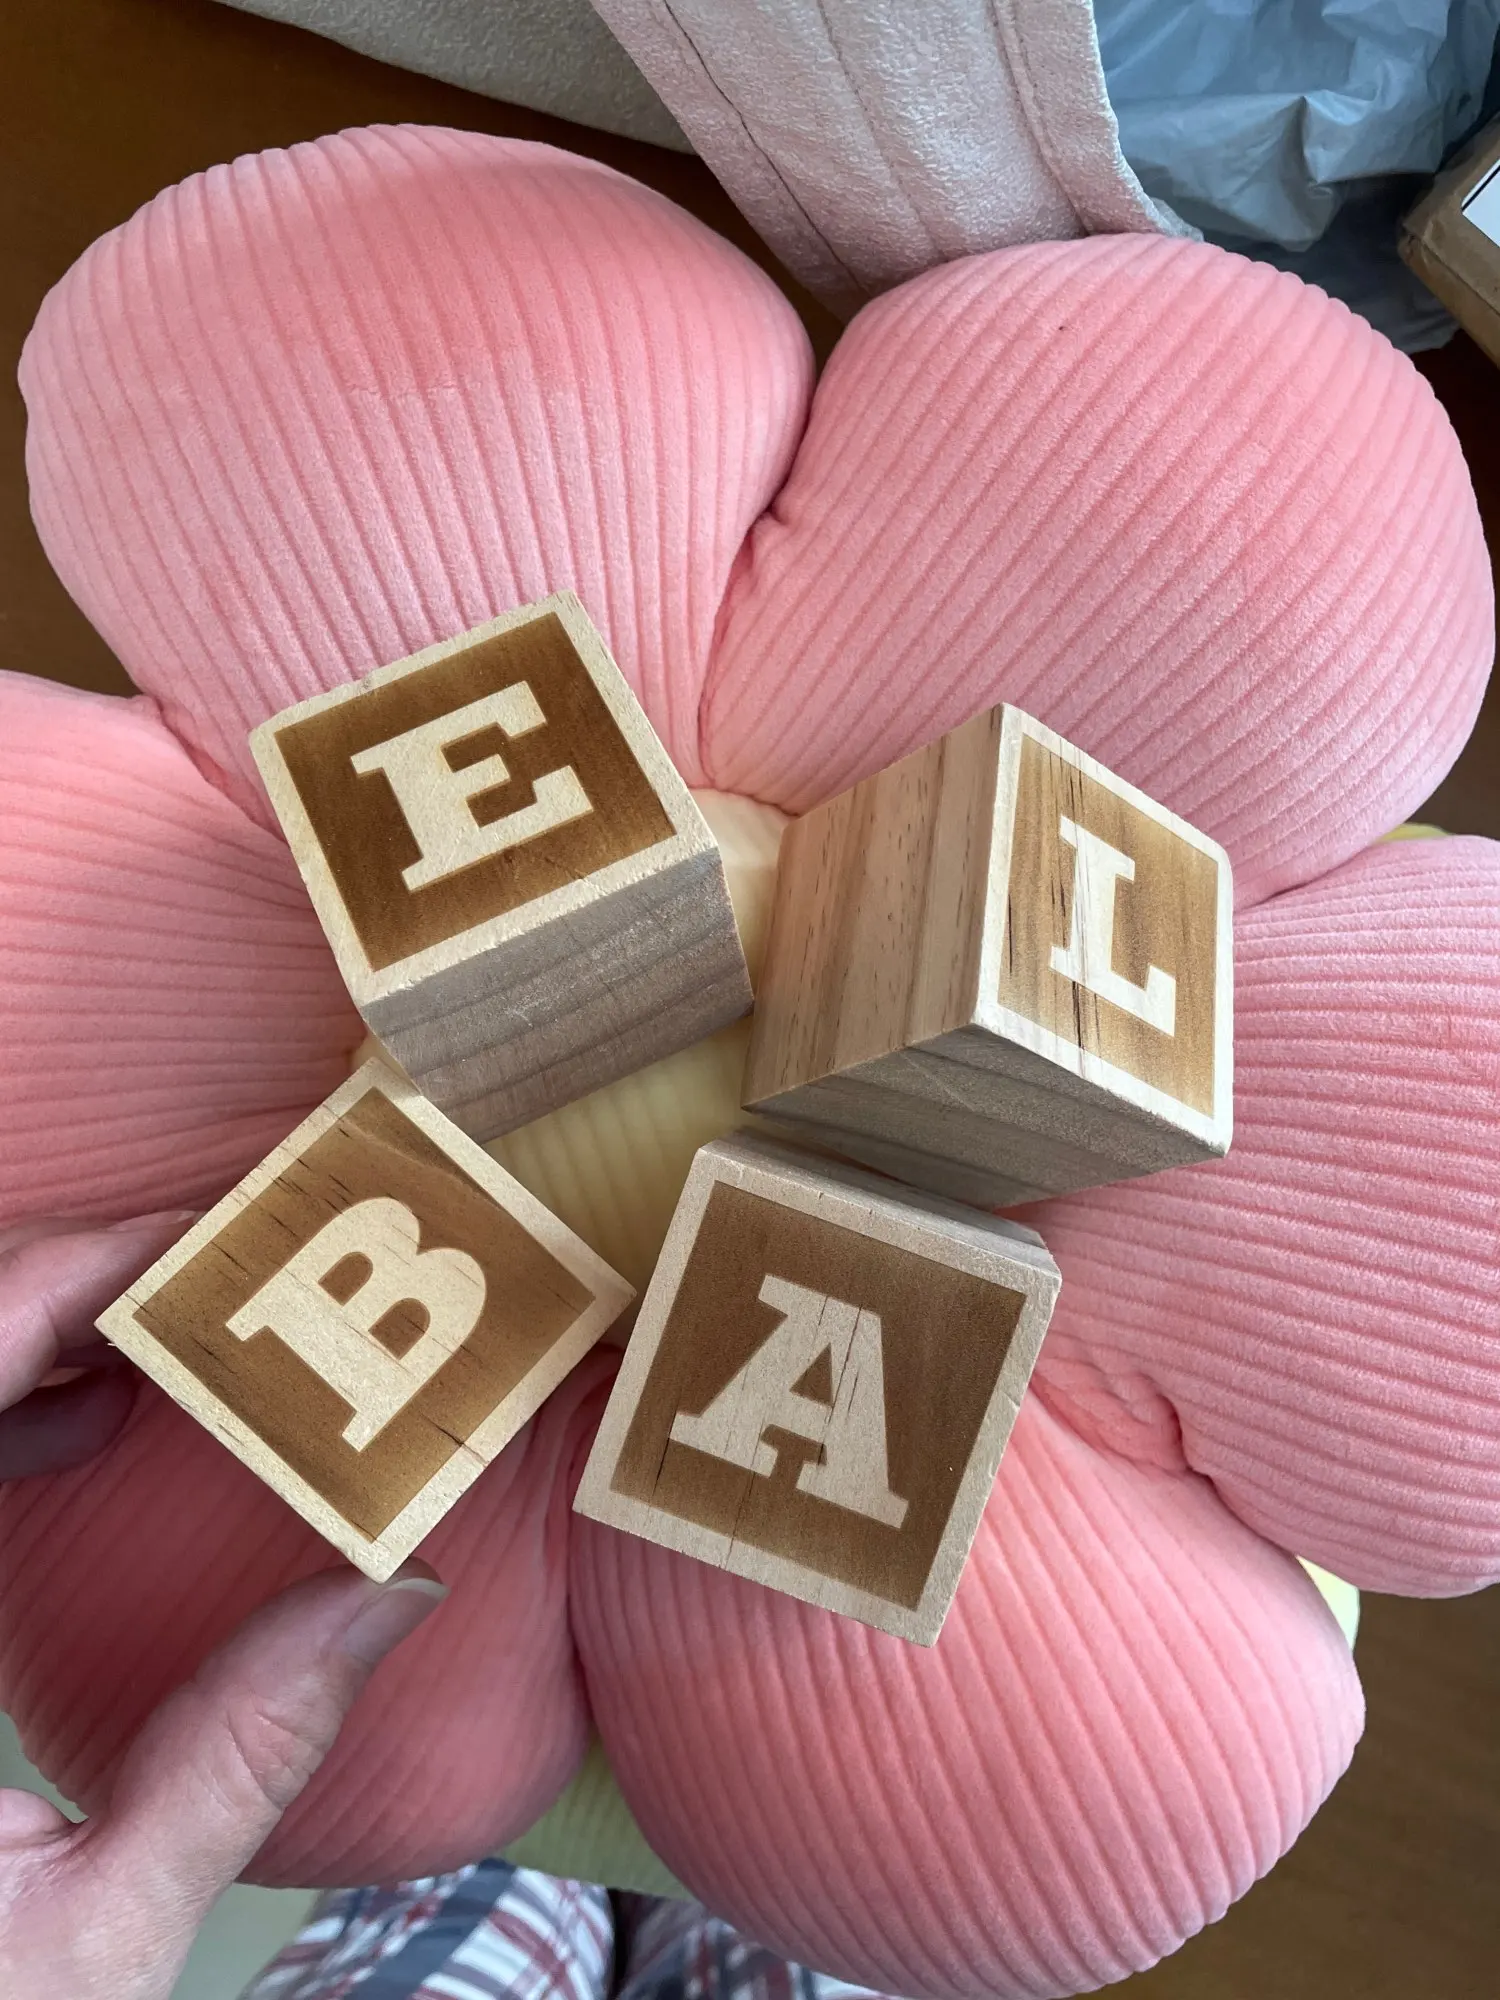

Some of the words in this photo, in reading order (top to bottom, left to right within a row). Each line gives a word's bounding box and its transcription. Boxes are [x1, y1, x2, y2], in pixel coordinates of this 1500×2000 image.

[351, 681, 593, 890] E
[1049, 815, 1177, 1037] L
[226, 1197, 486, 1452] B
[670, 1275, 909, 1529] A
